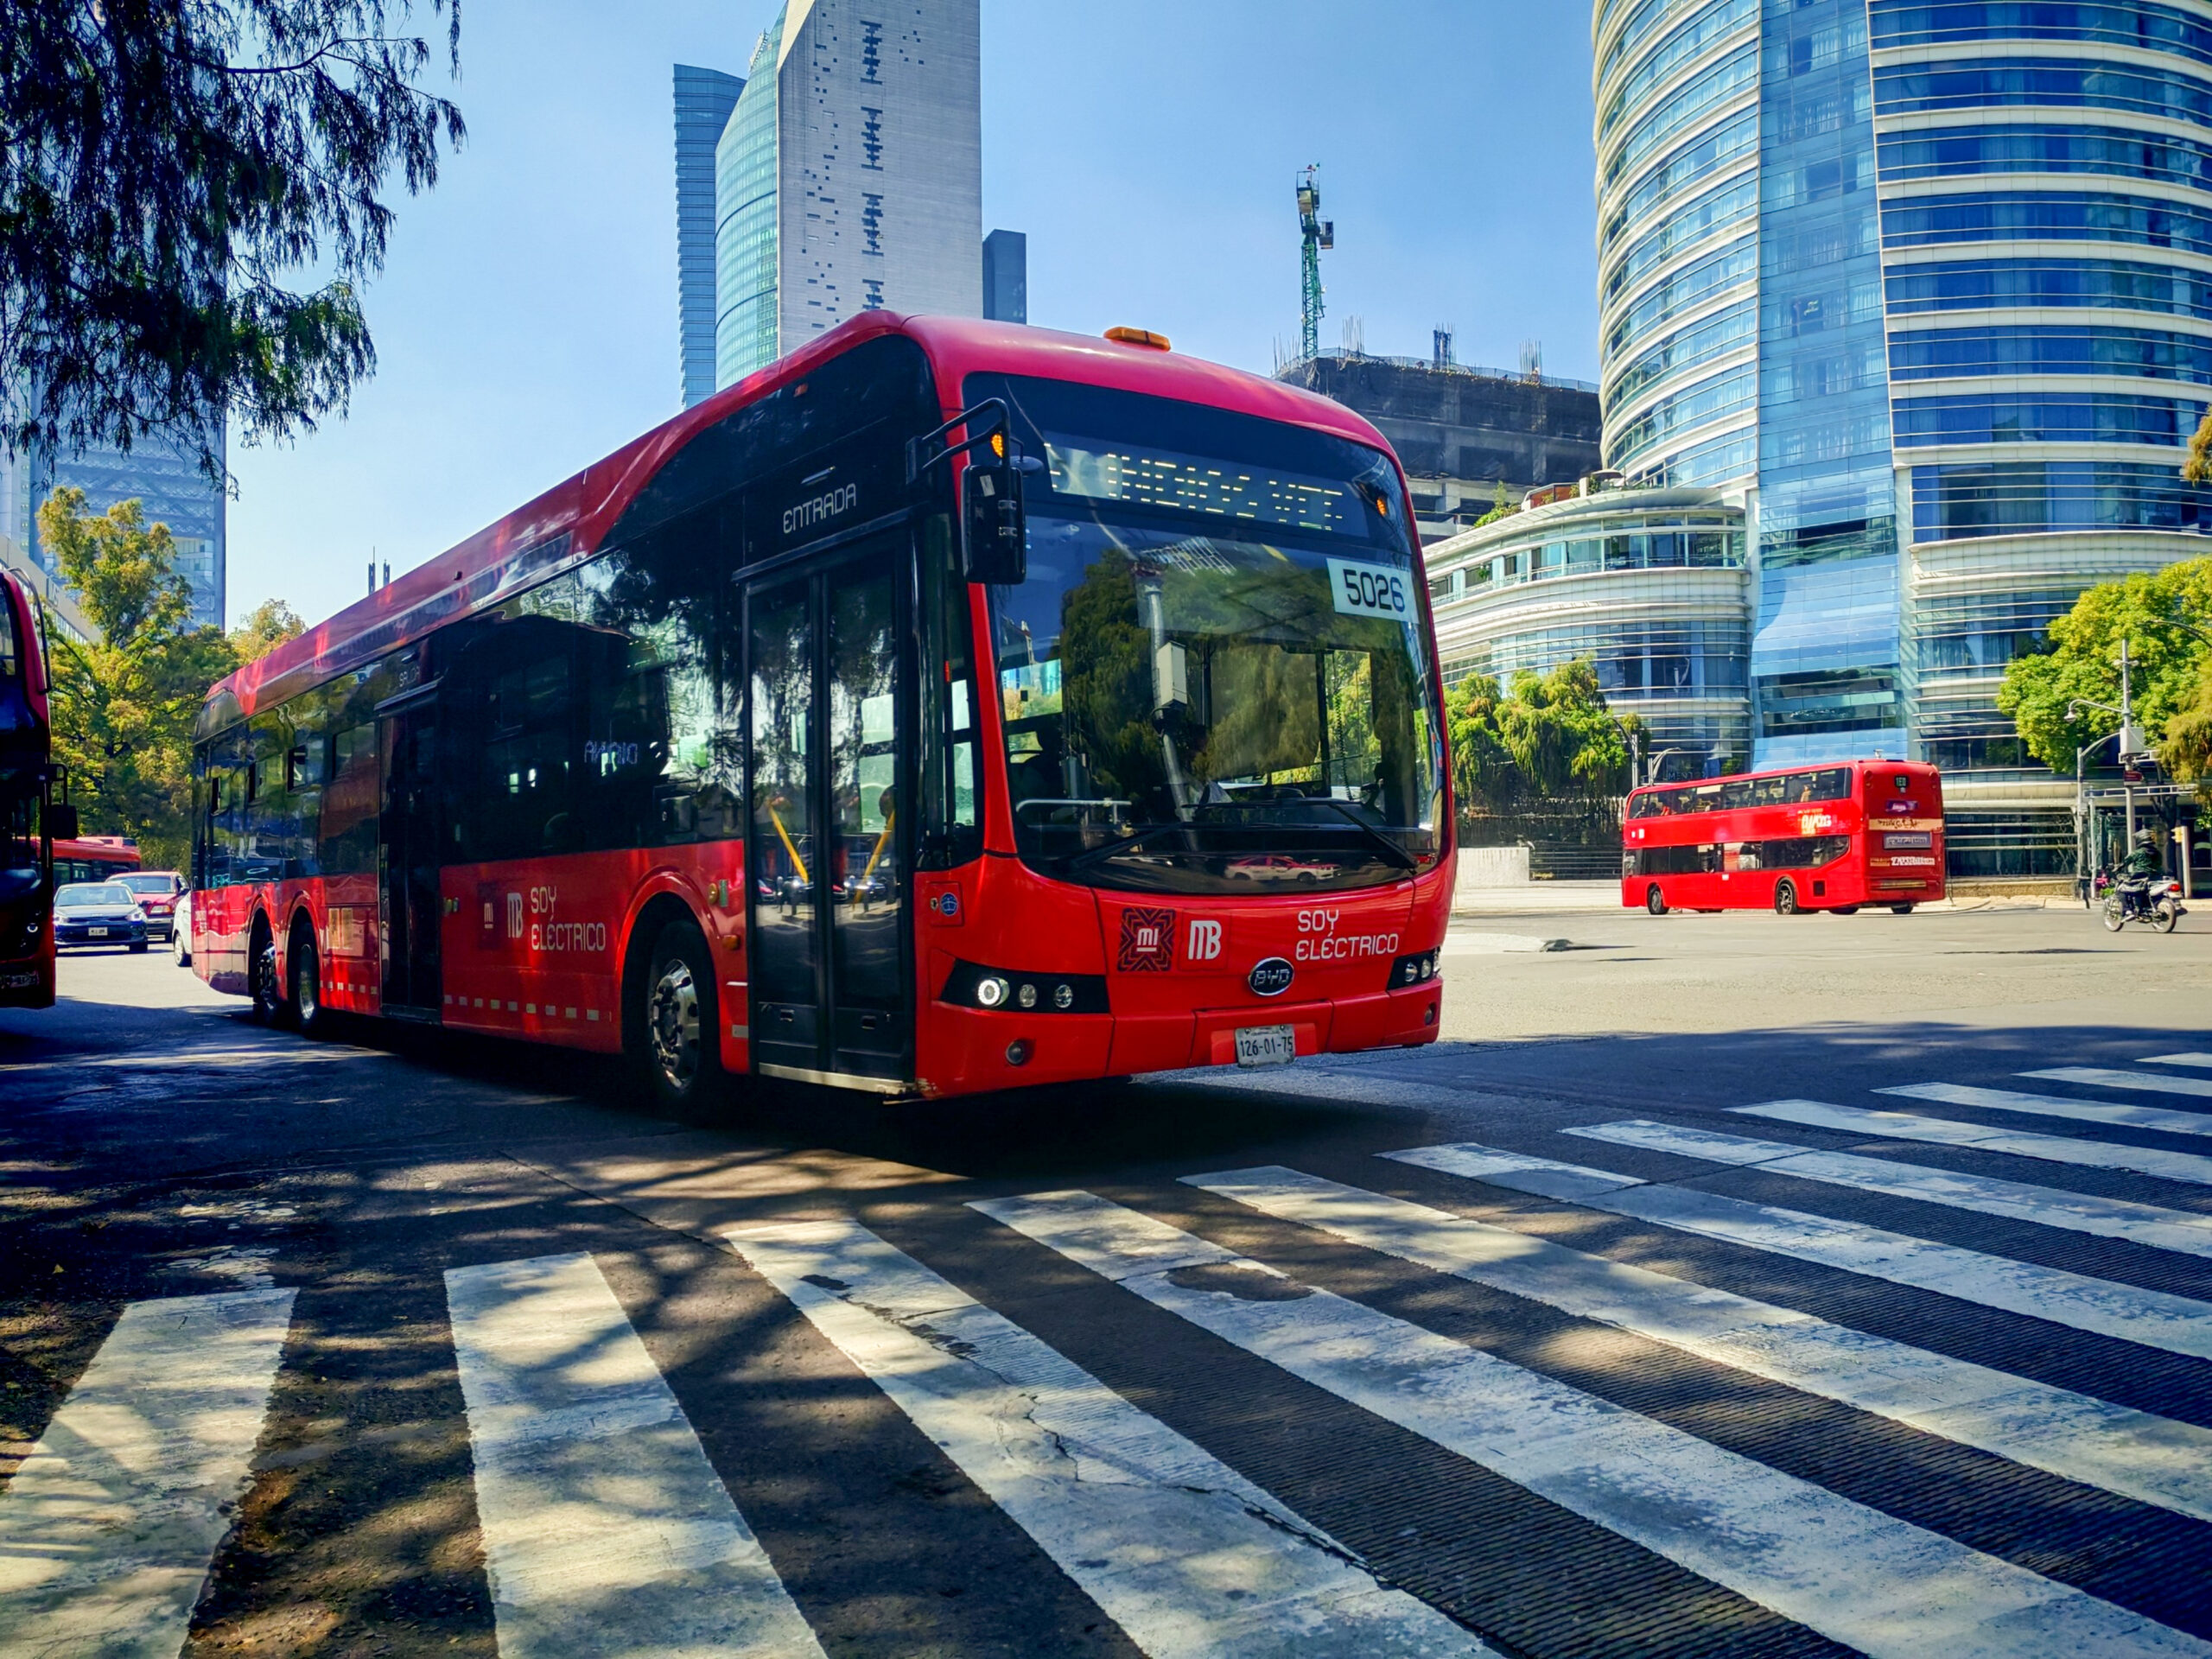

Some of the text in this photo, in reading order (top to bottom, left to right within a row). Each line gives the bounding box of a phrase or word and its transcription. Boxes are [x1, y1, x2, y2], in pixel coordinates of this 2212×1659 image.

[783, 482, 856, 534] ENTRADA
[1343, 569, 1406, 613] 5026
[507, 893, 524, 938] MB
[531, 886, 557, 913] SOY
[531, 914, 607, 951] ELÉCTRICO
[1297, 909, 1339, 932] SOY
[1187, 920, 1223, 960] MB
[1295, 931, 1399, 961] ELÉCTRICO
[1254, 969, 1290, 986] BYD
[1240, 1036, 1294, 1057] 126-01-75
